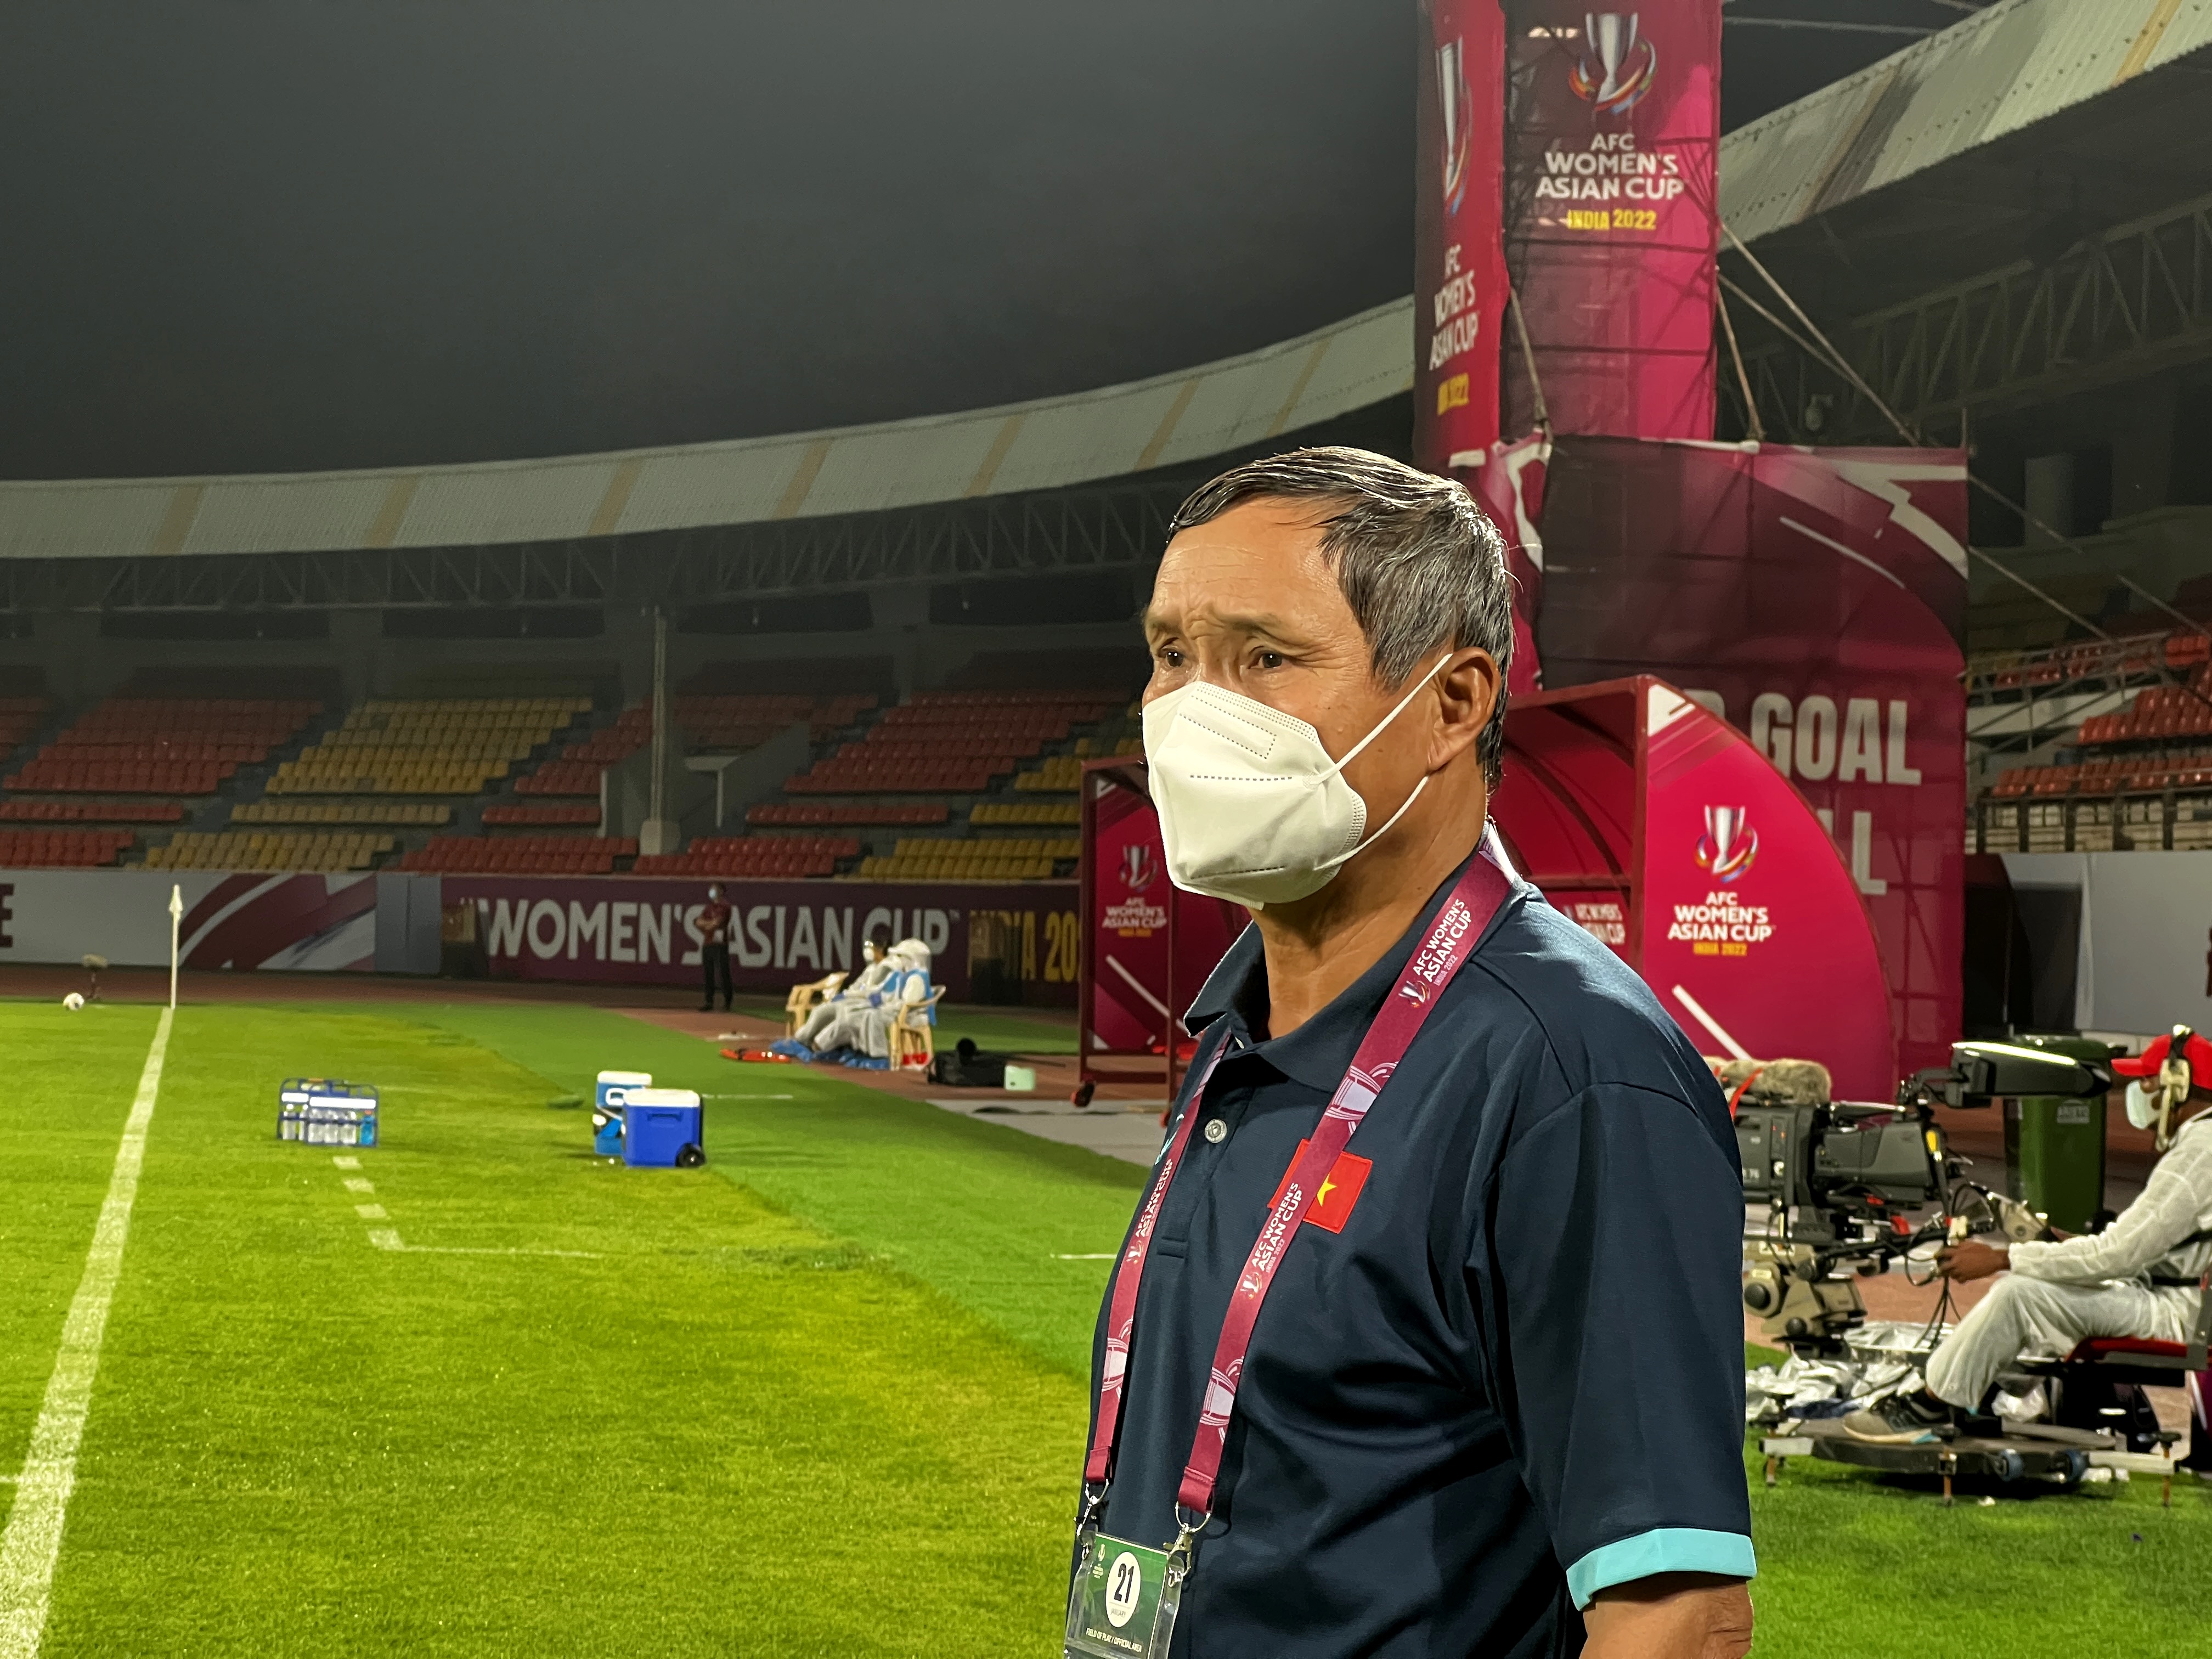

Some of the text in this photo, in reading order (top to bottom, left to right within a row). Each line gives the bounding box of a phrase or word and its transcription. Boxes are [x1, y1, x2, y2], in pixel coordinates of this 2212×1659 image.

[1591, 133, 1634, 150] AFC
[1545, 152, 1678, 175] WOMEN'S
[1536, 177, 1684, 200] ASIAN CUP
[1567, 209, 1656, 230] INDIA 2022
[1751, 692, 1921, 786] GOAL
[1706, 891, 1737, 905] AFC
[1674, 905, 1768, 924] WOMEN'S
[477, 898, 704, 964] WOMEN'S
[728, 905, 854, 969] ASIAN
[1413, 899, 1465, 975] AFC WOMEN'S
[1667, 922, 1772, 942] ASIAN CUP
[1423, 910, 1472, 982] ASIAN CUP
[1444, 955, 1458, 970] 2022
[1251, 1182, 1299, 1267] AFC WOMEN'S
[1258, 1190, 1302, 1271] ASIAN CUP
[1114, 1563, 1134, 1603] 21
[1097, 1631, 1103, 1639] OF
